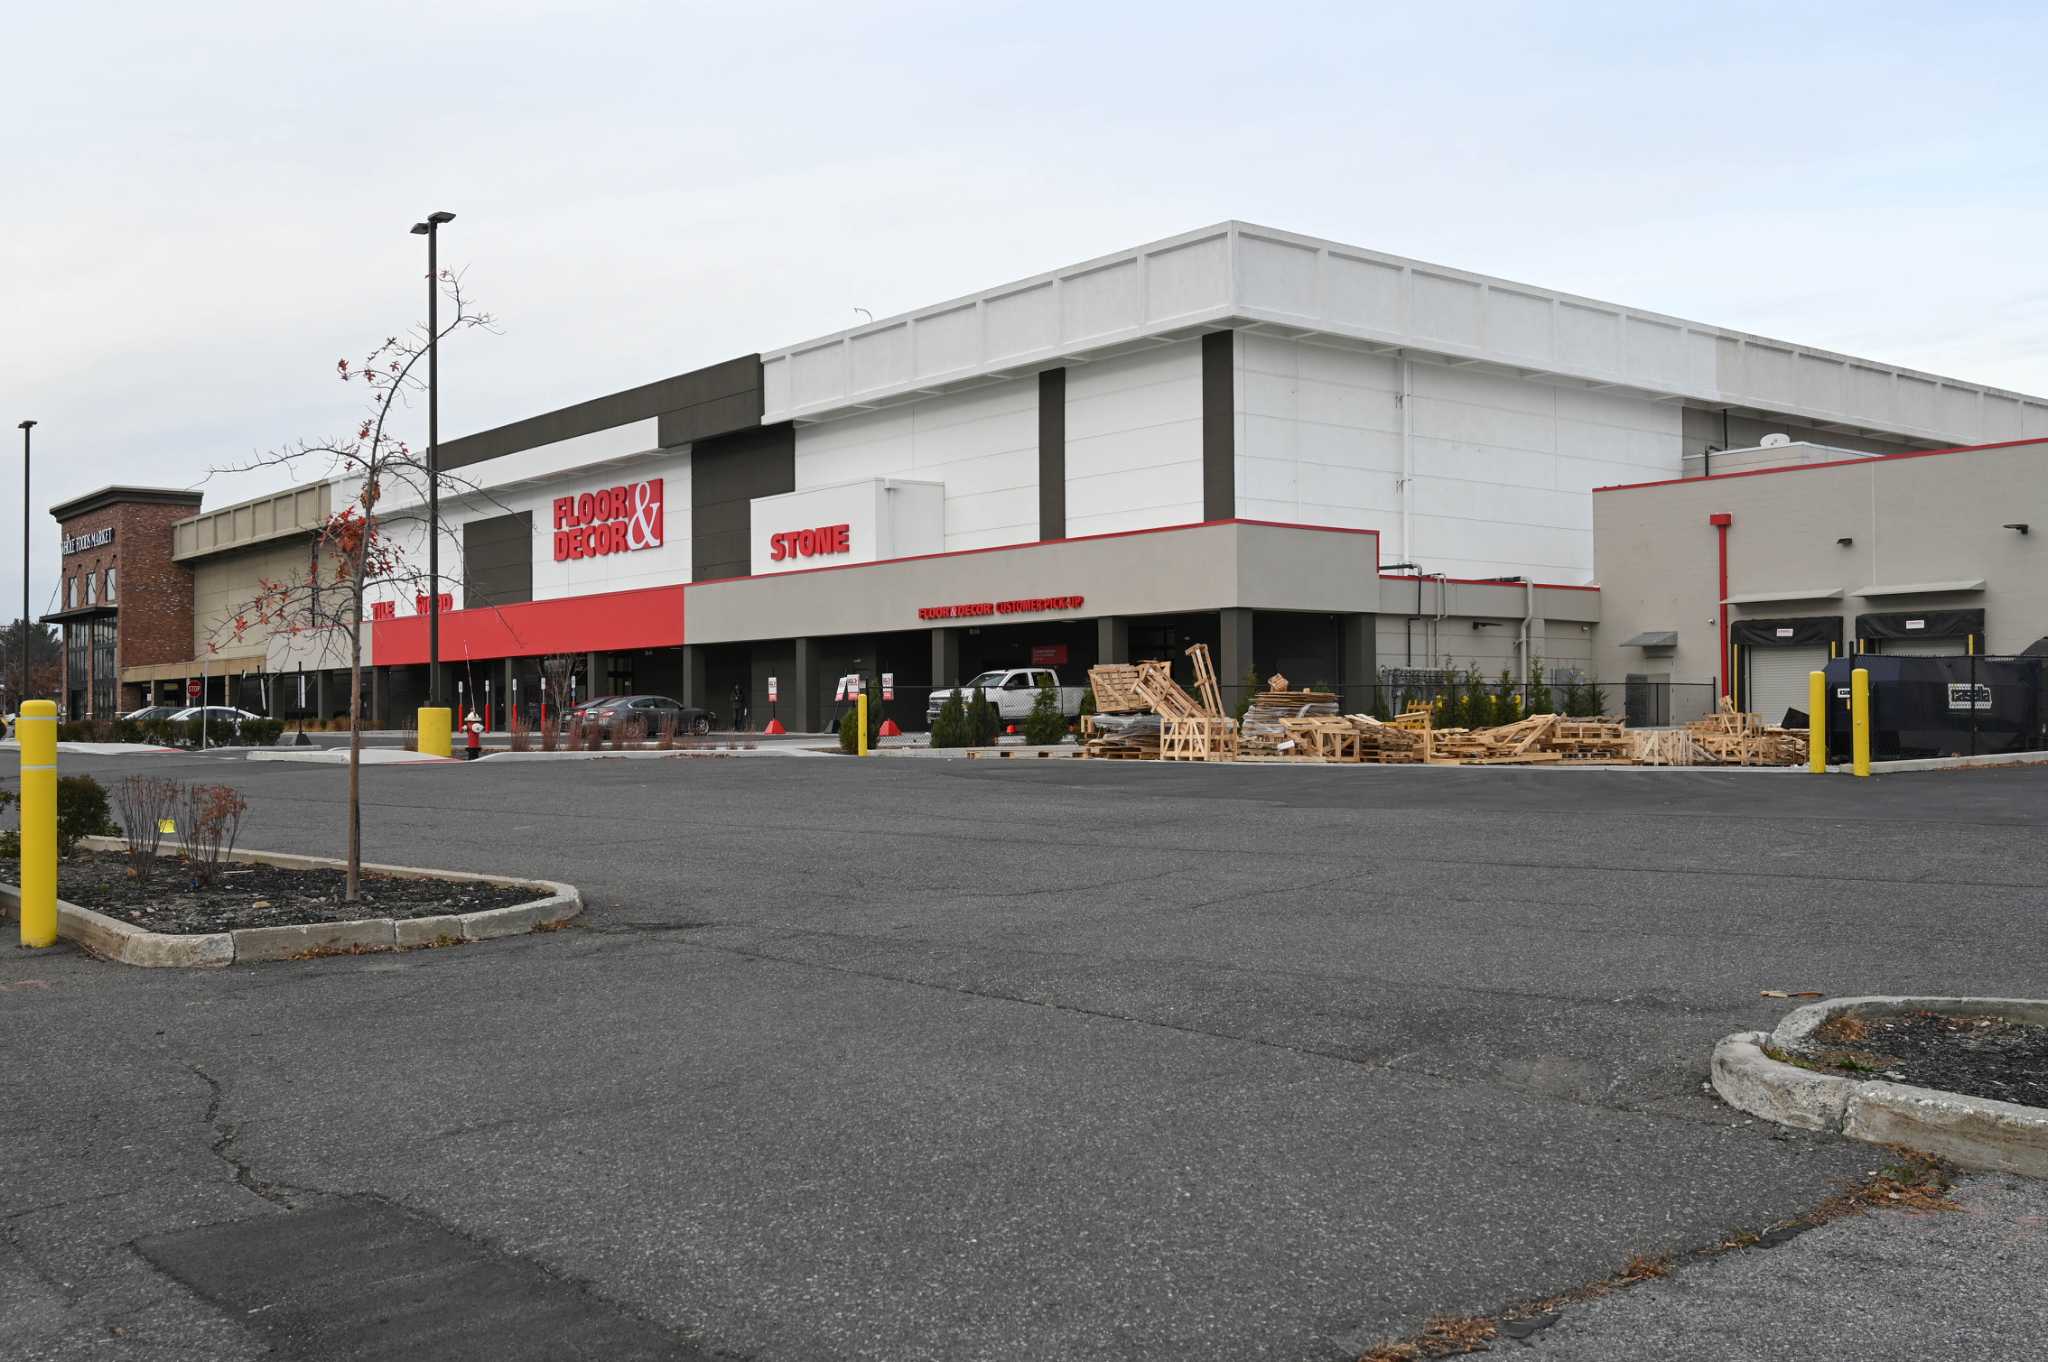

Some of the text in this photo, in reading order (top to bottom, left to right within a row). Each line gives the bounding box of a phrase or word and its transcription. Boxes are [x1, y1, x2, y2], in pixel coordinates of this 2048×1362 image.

[553, 480, 661, 550] FLOOR &
[91, 527, 112, 547] MARKET
[554, 521, 628, 562] DECOR
[770, 523, 849, 561] STONE
[371, 600, 395, 620] TILE
[416, 592, 453, 616] WD
[918, 606, 950, 619] FLOOR
[957, 603, 994, 615] DECOR
[996, 598, 1043, 613] CUSTOMER
[188, 685, 201, 693] STOP
